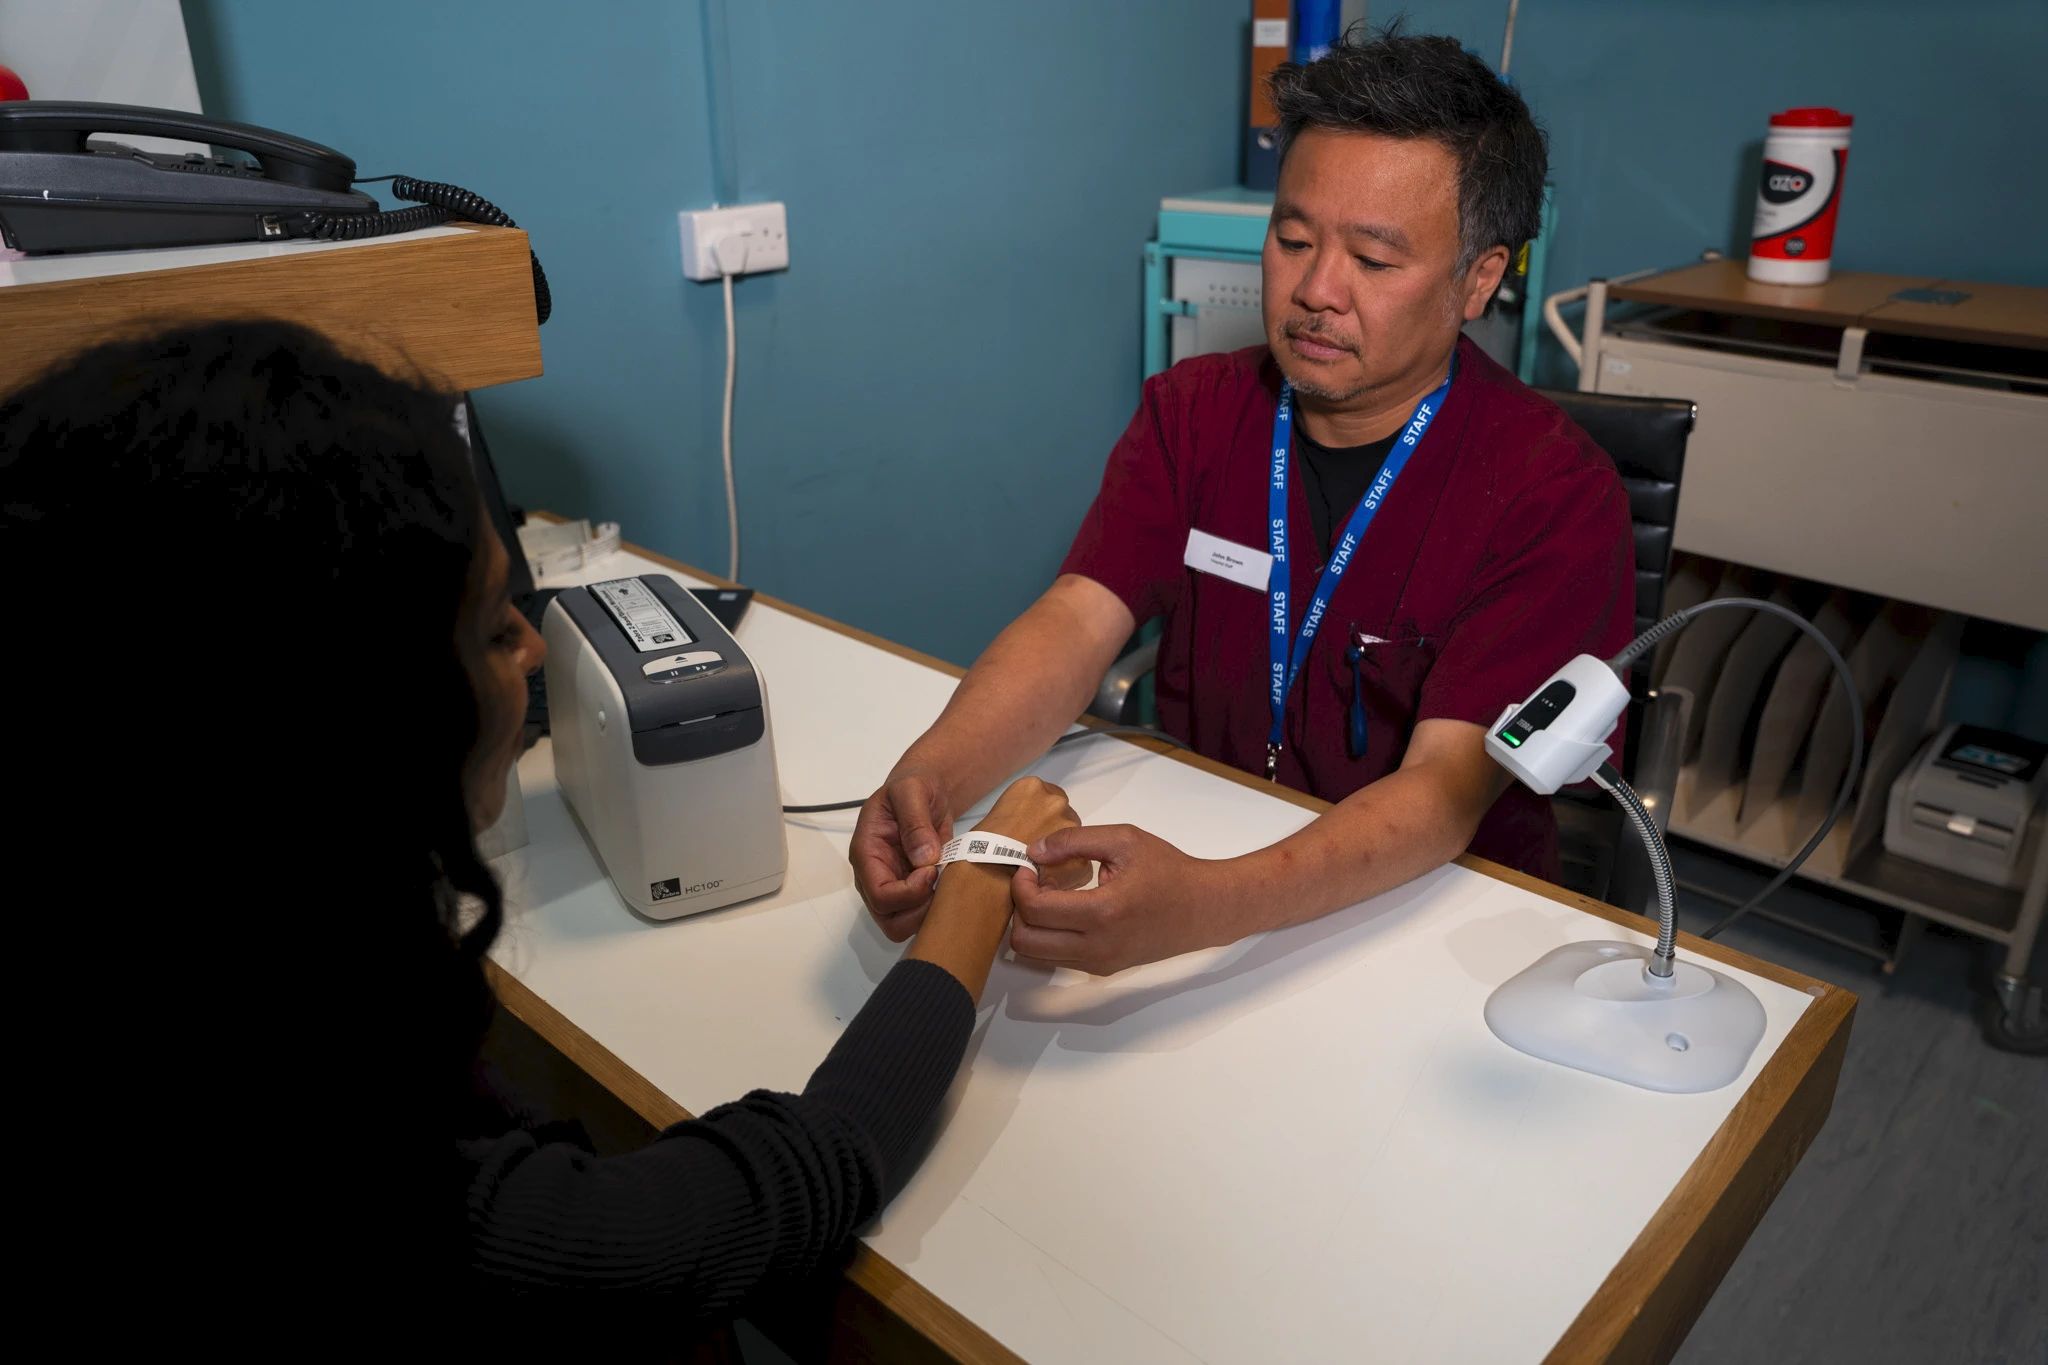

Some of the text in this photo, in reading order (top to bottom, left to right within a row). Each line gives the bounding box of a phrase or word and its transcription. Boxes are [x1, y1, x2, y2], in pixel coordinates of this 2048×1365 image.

[1278, 384, 1291, 421] STAFF
[1403, 403, 1433, 446] STAFF
[1273, 448, 1286, 490] STAFF
[1365, 467, 1393, 510] STAFF
[1212, 551, 1244, 566] John Brown
[1272, 518, 1286, 562] STAFF
[1331, 532, 1357, 575] STAFF
[1273, 591, 1285, 635] STAFF
[1303, 597, 1327, 638] STAFF
[1272, 663, 1284, 705] STAFF
